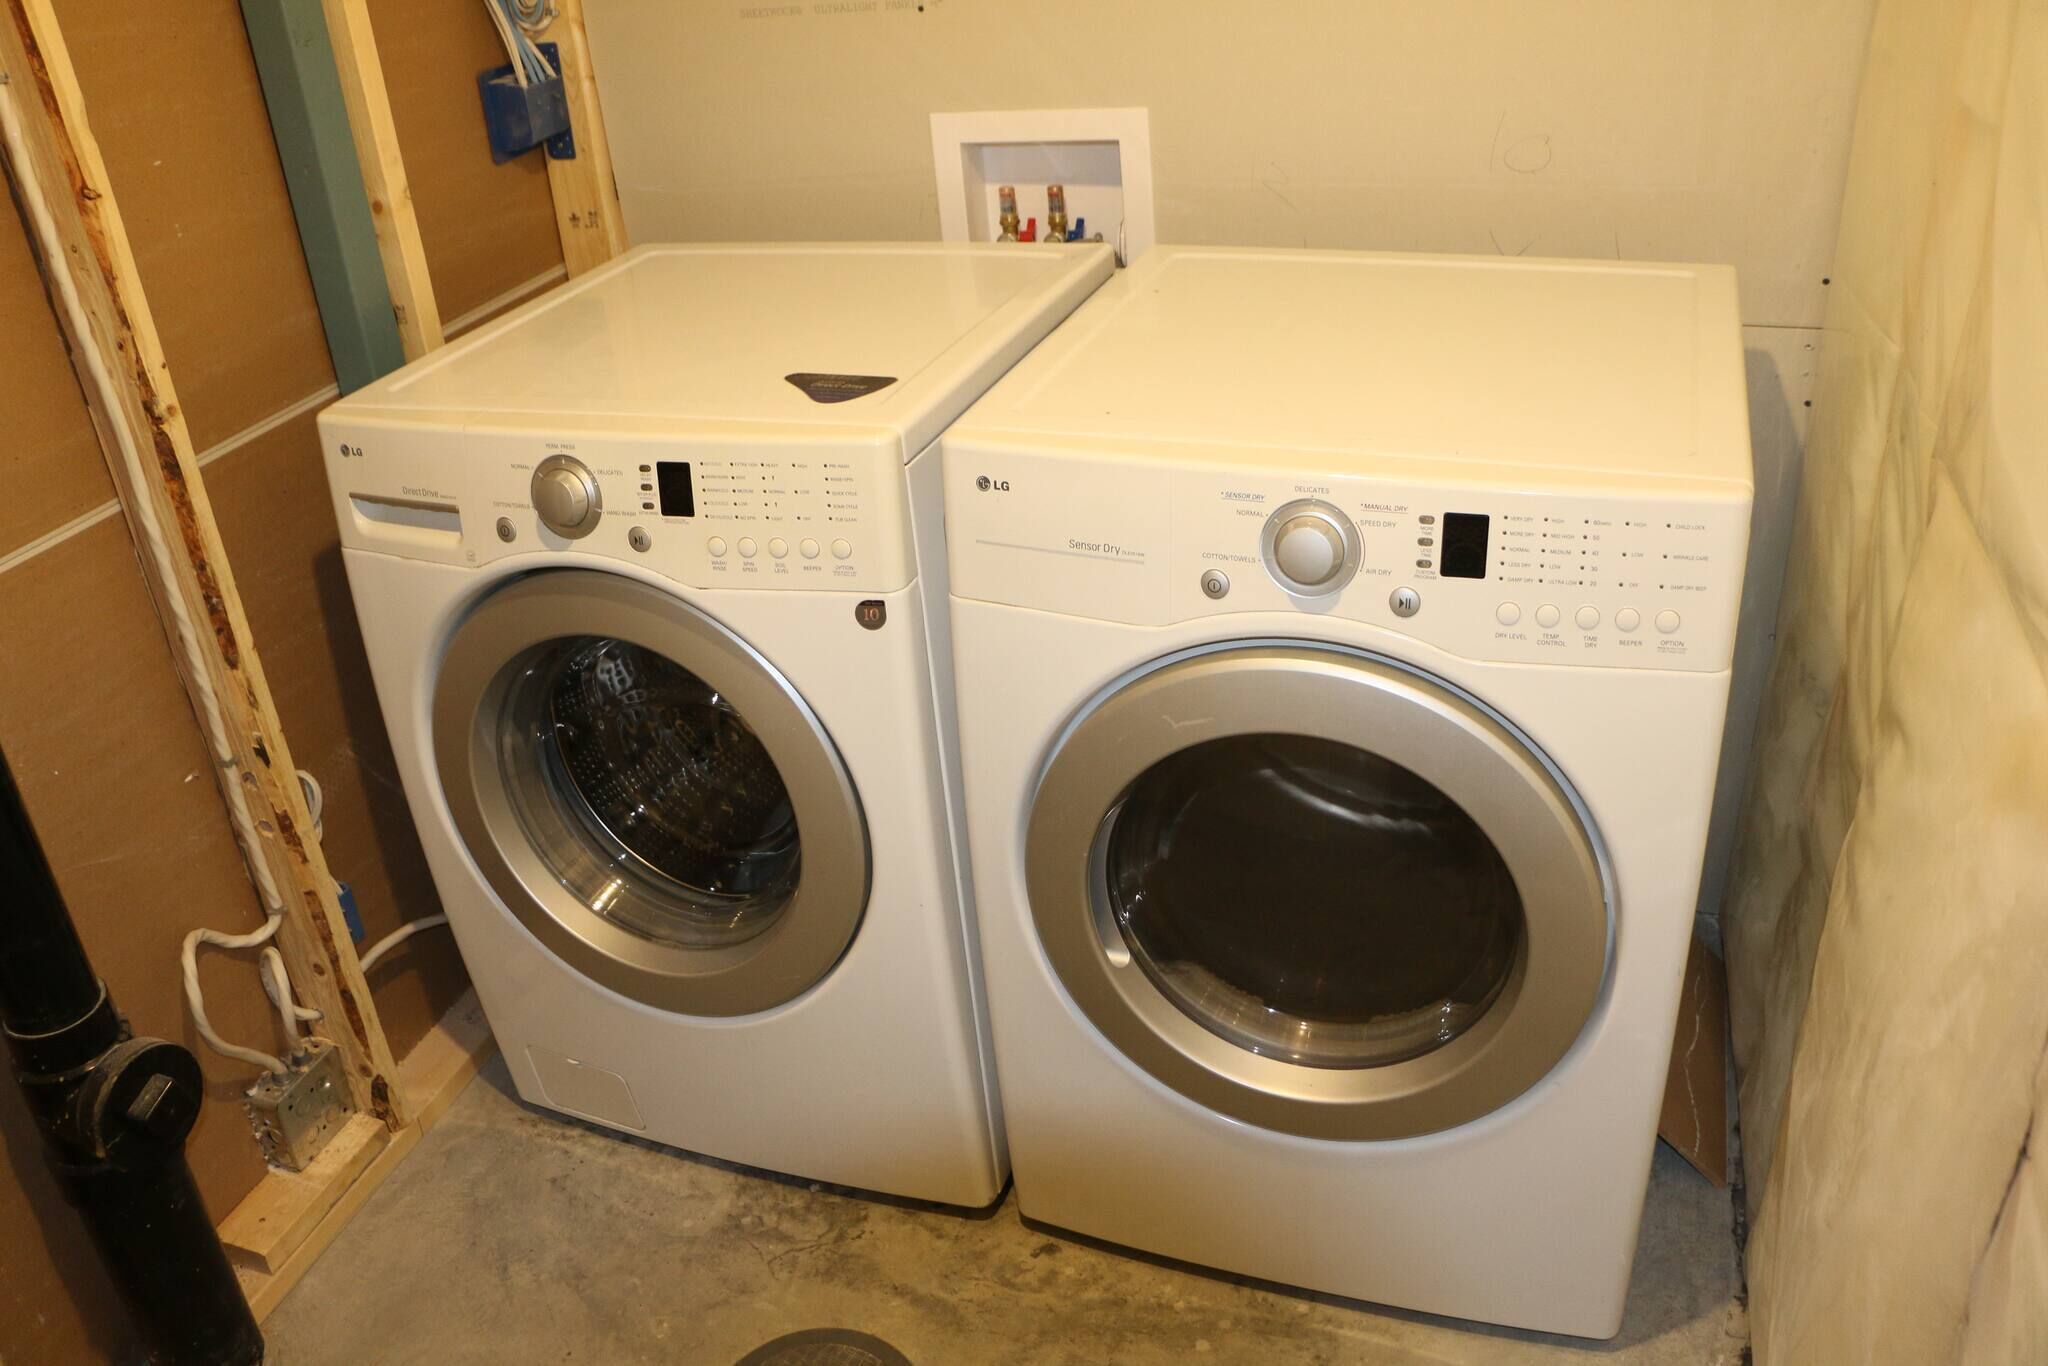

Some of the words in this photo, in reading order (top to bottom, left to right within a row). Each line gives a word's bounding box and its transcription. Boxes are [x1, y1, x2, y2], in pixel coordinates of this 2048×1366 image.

[351, 447, 363, 457] LG
[994, 480, 1009, 491] LG
[1294, 485, 1330, 495] DELICATES
[1251, 493, 1265, 501] DRY
[1236, 509, 1264, 518] NORMAL
[1360, 519, 1382, 528] SPEED
[1069, 539, 1101, 552] Sensor
[1103, 544, 1121, 556] Dry
[1202, 552, 1256, 564] COTTON/TOWELS
[1365, 568, 1376, 576] AIR
[1377, 569, 1392, 577] DRY
[863, 607, 880, 621] 10
